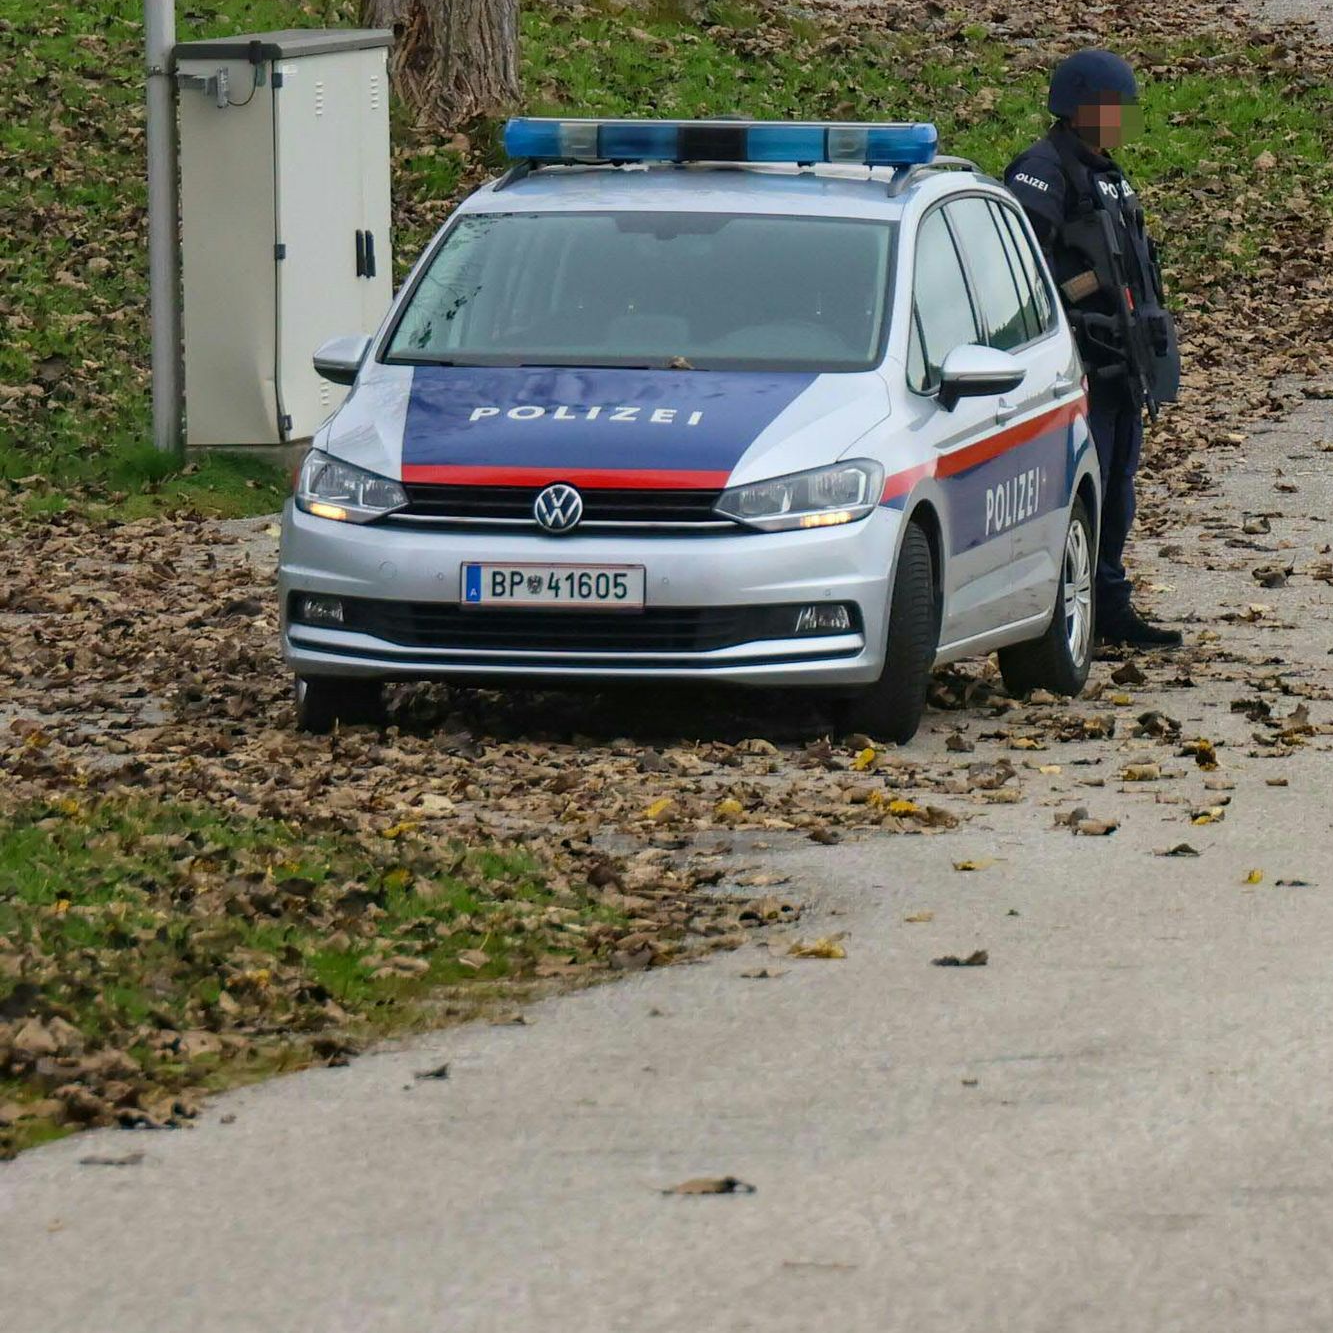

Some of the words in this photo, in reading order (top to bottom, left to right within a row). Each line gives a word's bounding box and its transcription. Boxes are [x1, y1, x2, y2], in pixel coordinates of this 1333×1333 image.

[1014, 172, 1049, 192] OLIZEI
[469, 405, 704, 426] POLIZEI
[985, 466, 1040, 536] POLIZEI
[469, 587, 478, 598] A
[491, 570, 524, 598] BP
[547, 571, 628, 600] 41605
